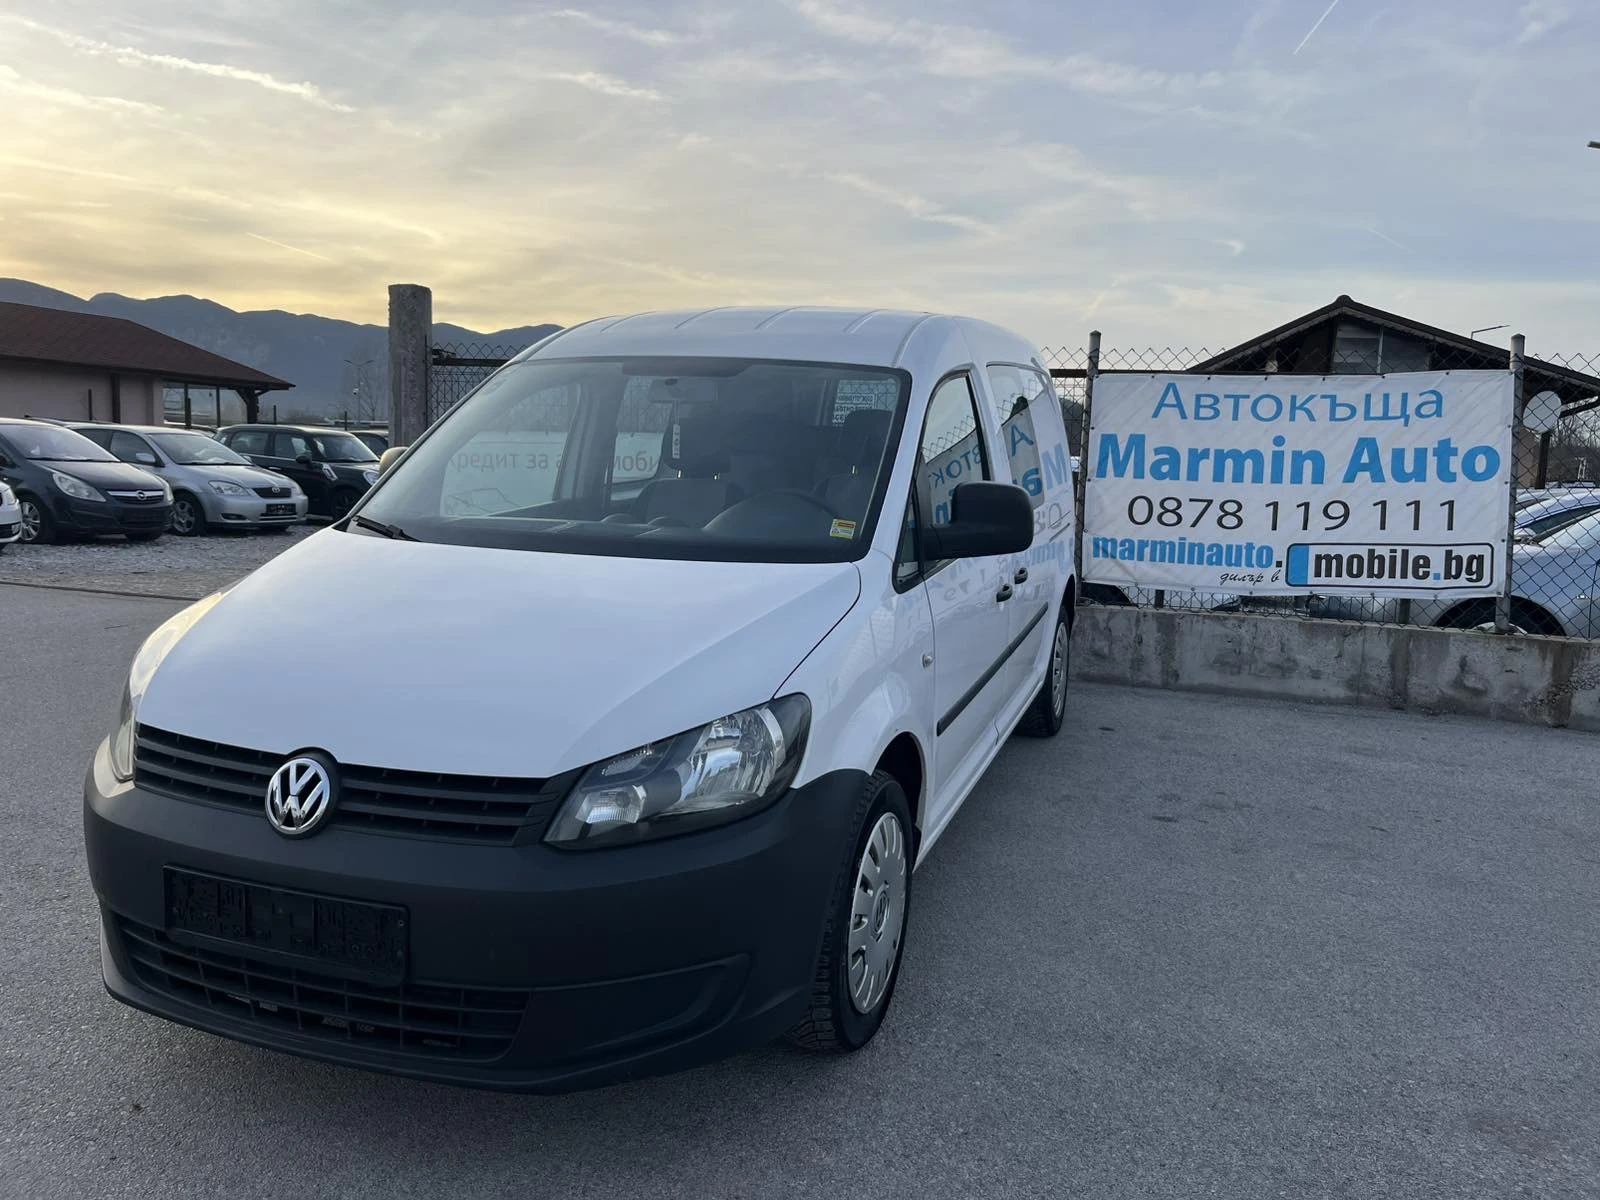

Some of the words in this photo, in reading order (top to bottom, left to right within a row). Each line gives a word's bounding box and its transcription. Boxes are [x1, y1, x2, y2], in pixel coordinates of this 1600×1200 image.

[1152, 382, 1444, 427] Автокъща
[1096, 433, 1326, 485] Marmin
[1343, 437, 1500, 484] Auto
[1127, 496, 1244, 530] 0878
[1265, 500, 1351, 531] 119
[1372, 500, 1456, 531] 111
[1092, 536, 1283, 569] marminauto.
[1314, 548, 1485, 583] mobile.bg
